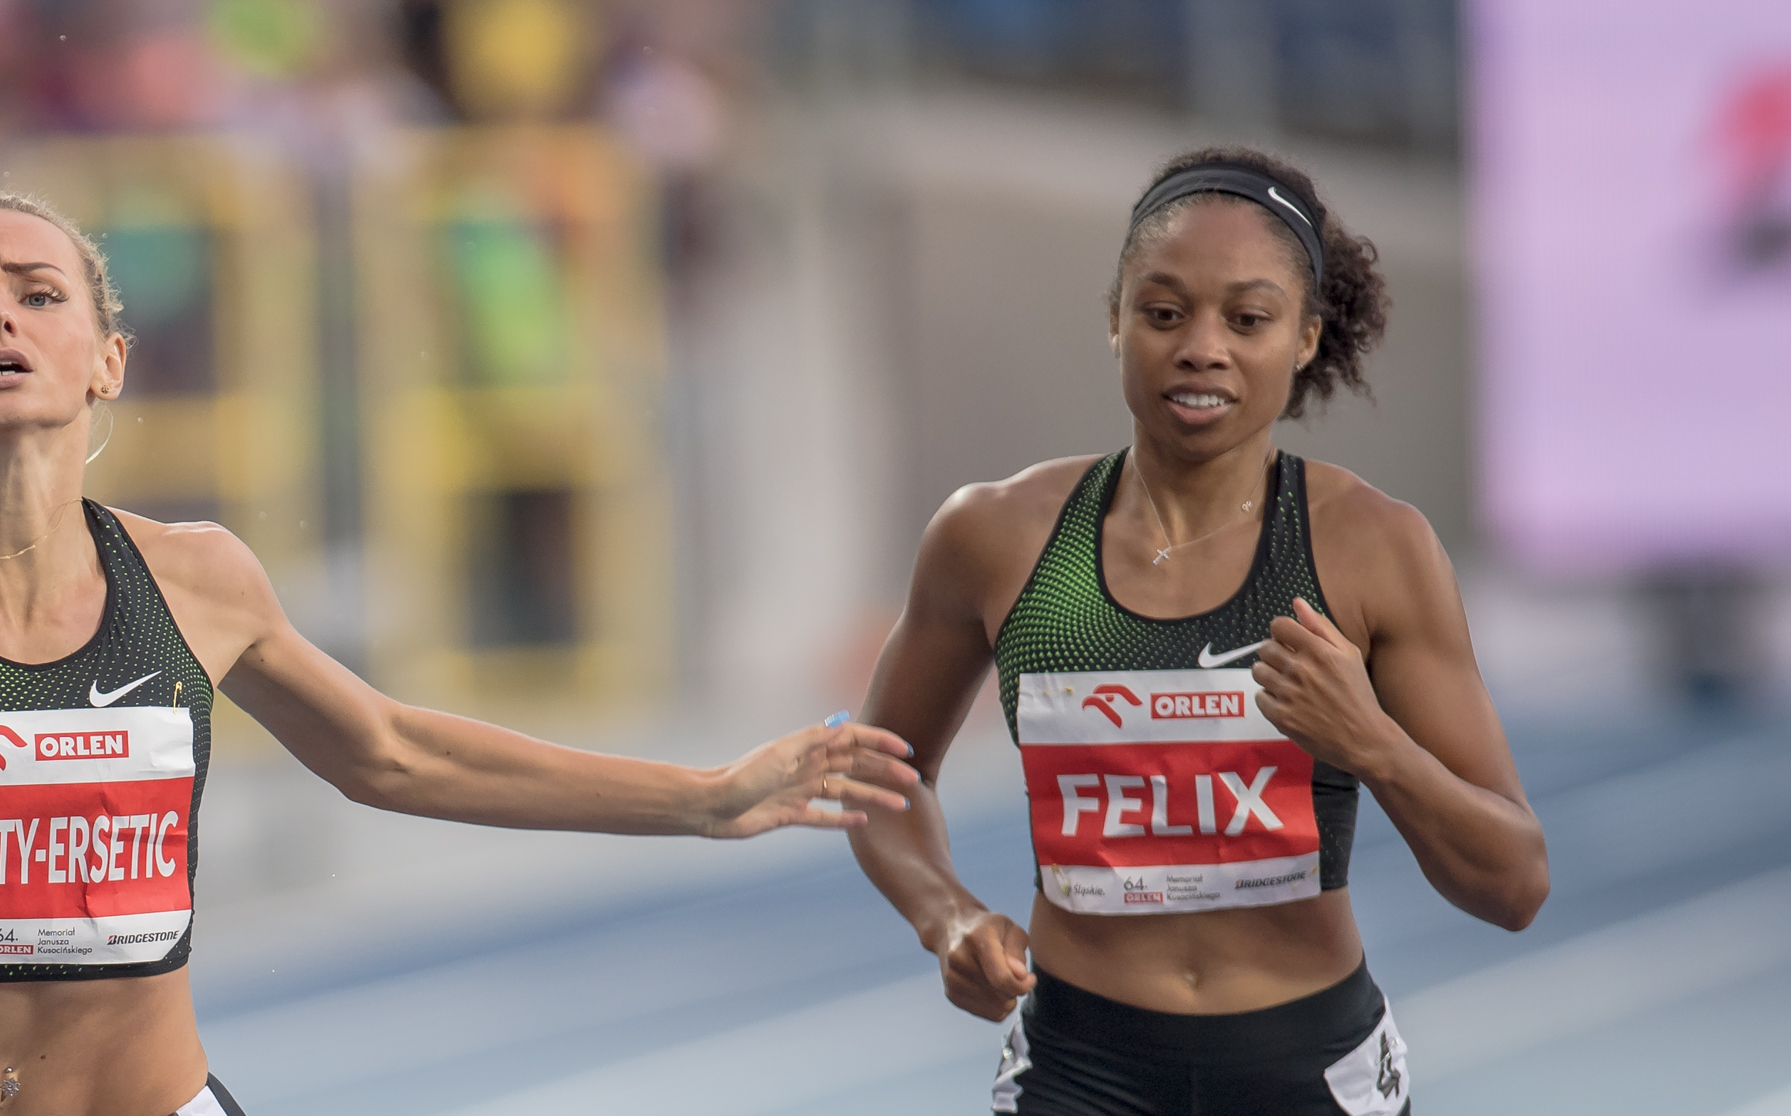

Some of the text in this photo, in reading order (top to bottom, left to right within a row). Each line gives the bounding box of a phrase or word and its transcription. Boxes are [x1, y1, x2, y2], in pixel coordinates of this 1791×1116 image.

[1154, 693, 1239, 717] ORLEN
[39, 734, 123, 758] ORLEN
[1057, 766, 1284, 838] FELIX
[37, 927, 75, 937] Memoriał
[37, 937, 69, 946] Janusza
[107, 930, 179, 945] BRIDGESTONE
